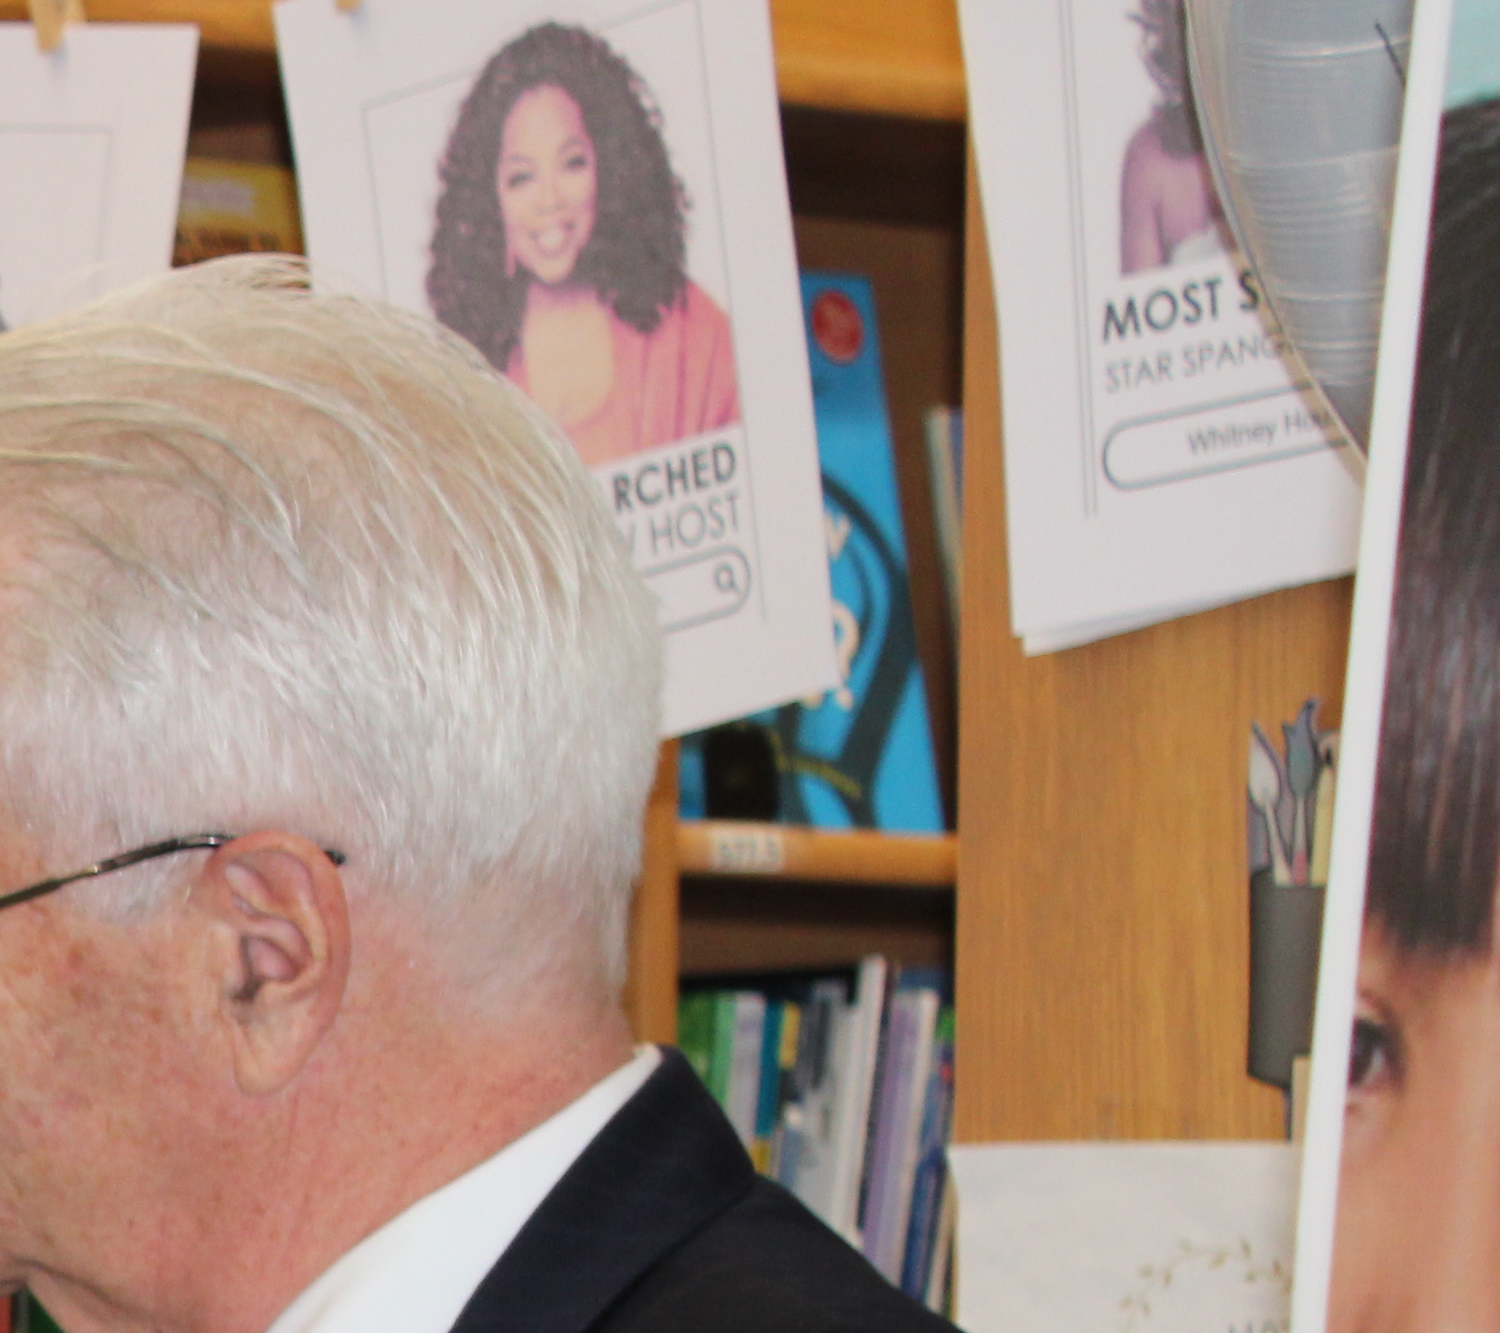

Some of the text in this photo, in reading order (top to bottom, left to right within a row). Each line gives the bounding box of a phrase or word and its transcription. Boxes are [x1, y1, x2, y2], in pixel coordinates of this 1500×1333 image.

[1103, 276, 1222, 344] MOST
[1106, 352, 1173, 394] STAR
[1188, 418, 1276, 454] Whitney
[650, 491, 740, 555] HOST
